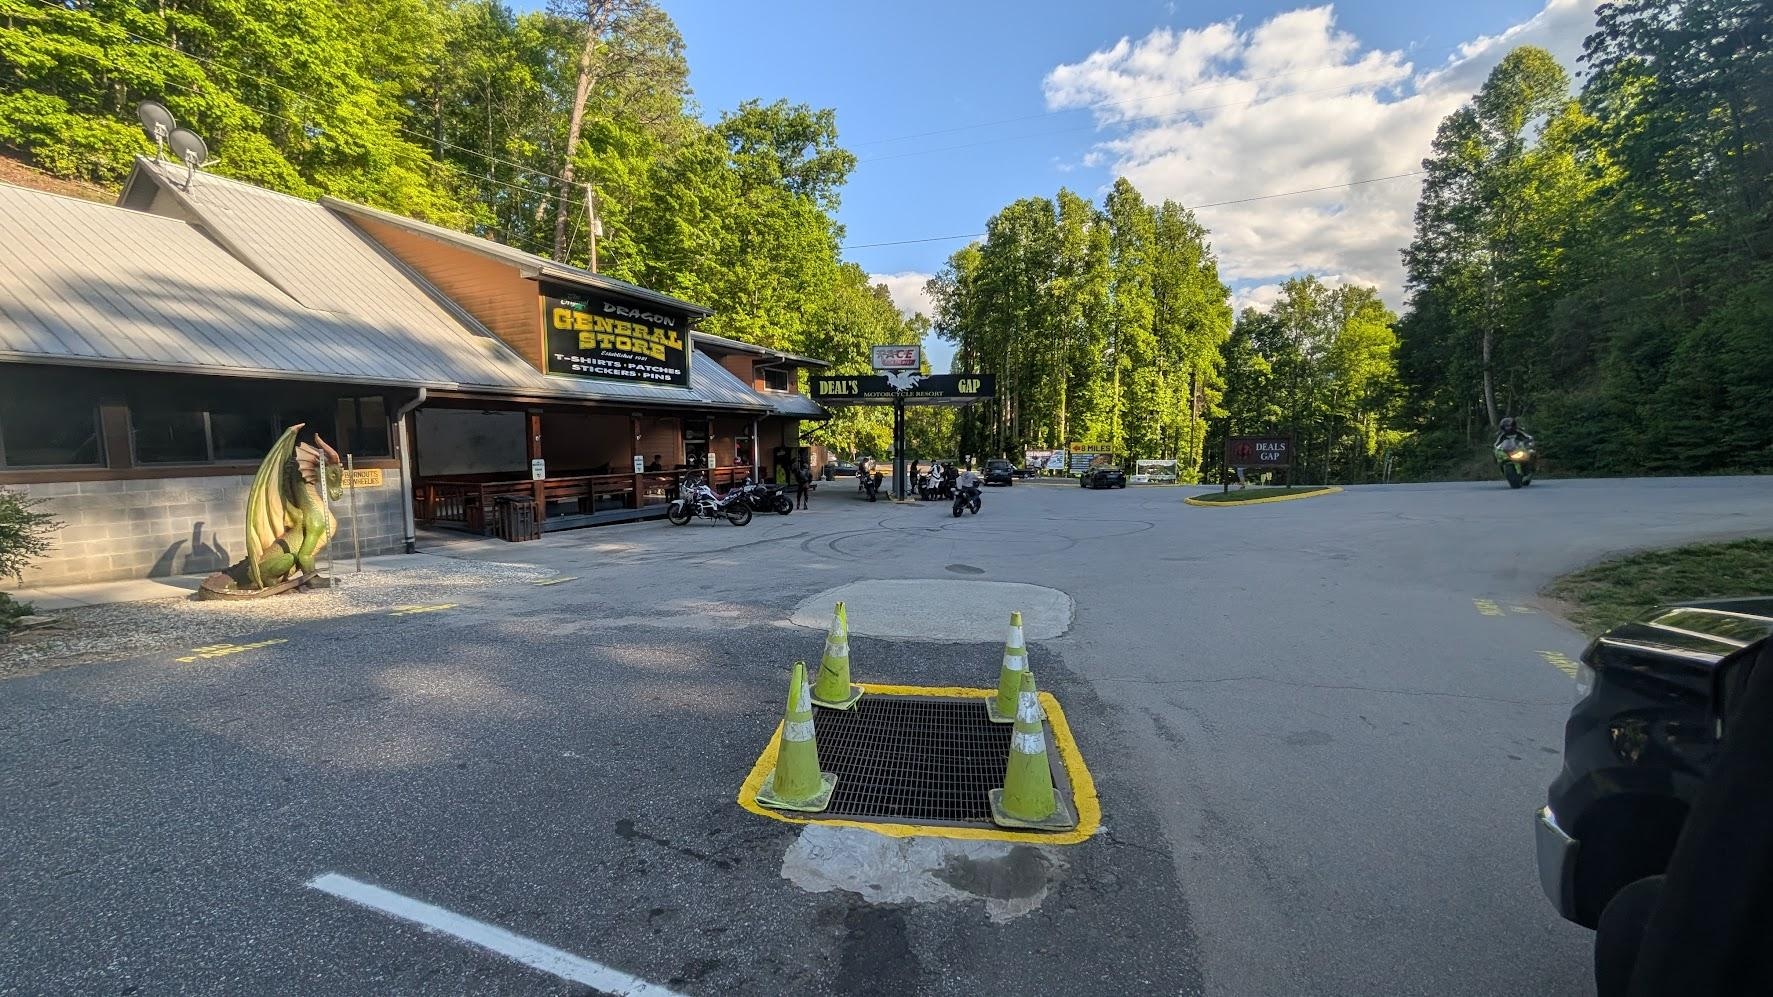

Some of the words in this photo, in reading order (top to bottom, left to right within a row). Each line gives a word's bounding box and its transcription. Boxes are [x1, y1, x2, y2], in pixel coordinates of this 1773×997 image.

[602, 301, 675, 326] DRAGON
[553, 307, 683, 351] GENERAL
[578, 331, 666, 361] STORE
[554, 353, 621, 368] T-SHIRTS
[628, 363, 681, 375] PATCHES
[572, 364, 637, 377] STICKERS
[643, 372, 671, 381] PINS
[819, 380, 858, 395] DEAL'S
[958, 379, 981, 394] GAP
[1256, 443, 1286, 451] DEALS
[1260, 452, 1280, 461] GAP
